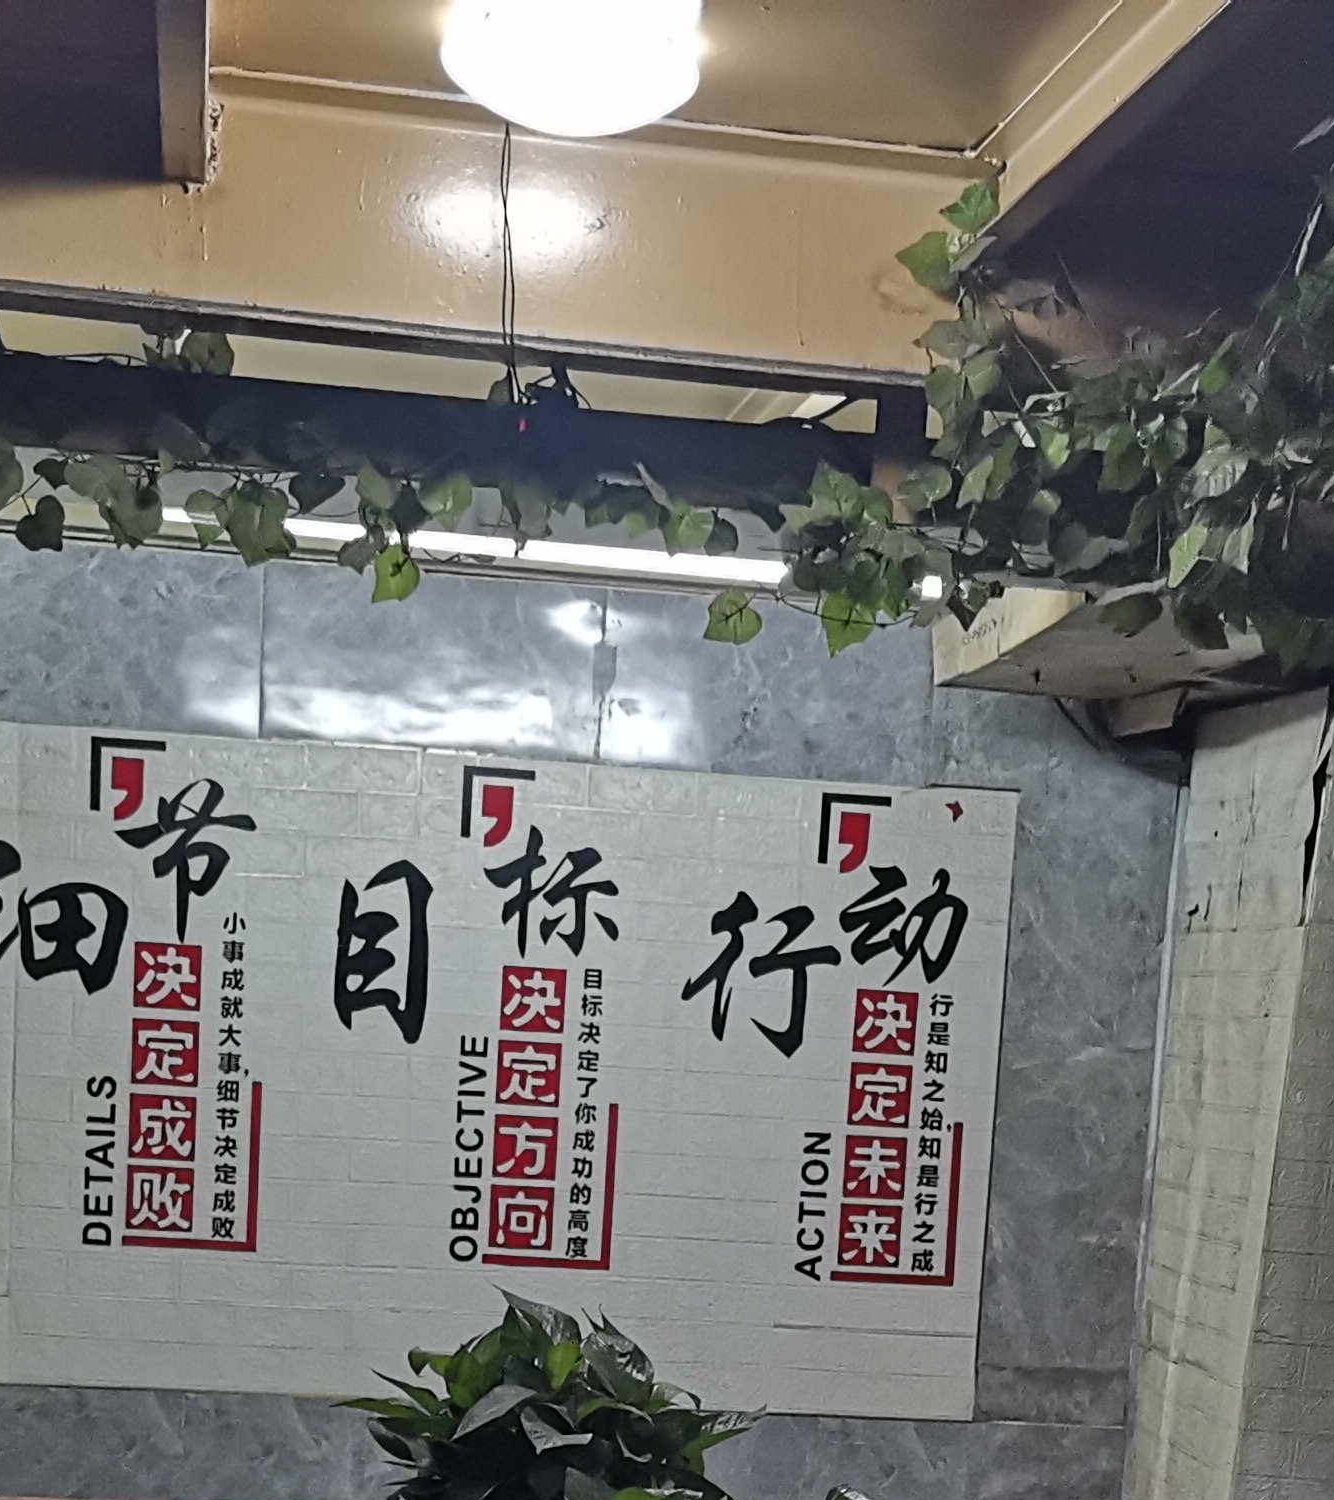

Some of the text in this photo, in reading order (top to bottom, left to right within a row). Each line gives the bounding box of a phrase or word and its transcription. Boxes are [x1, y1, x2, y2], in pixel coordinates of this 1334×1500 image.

[333, 825, 619, 1044] 目标
[681, 864, 969, 1059] 行动
[82, 1075, 117, 1247] DETAILS
[130, 946, 198, 1230] 决定成败
[449, 1035, 489, 1263] OBJECTIVE
[492, 970, 561, 1247] 决定方向
[565, 968, 603, 1259] 目标决定了你成功的高度
[841, 994, 913, 1264] 决定未来
[794, 1131, 832, 1282] ACTION
